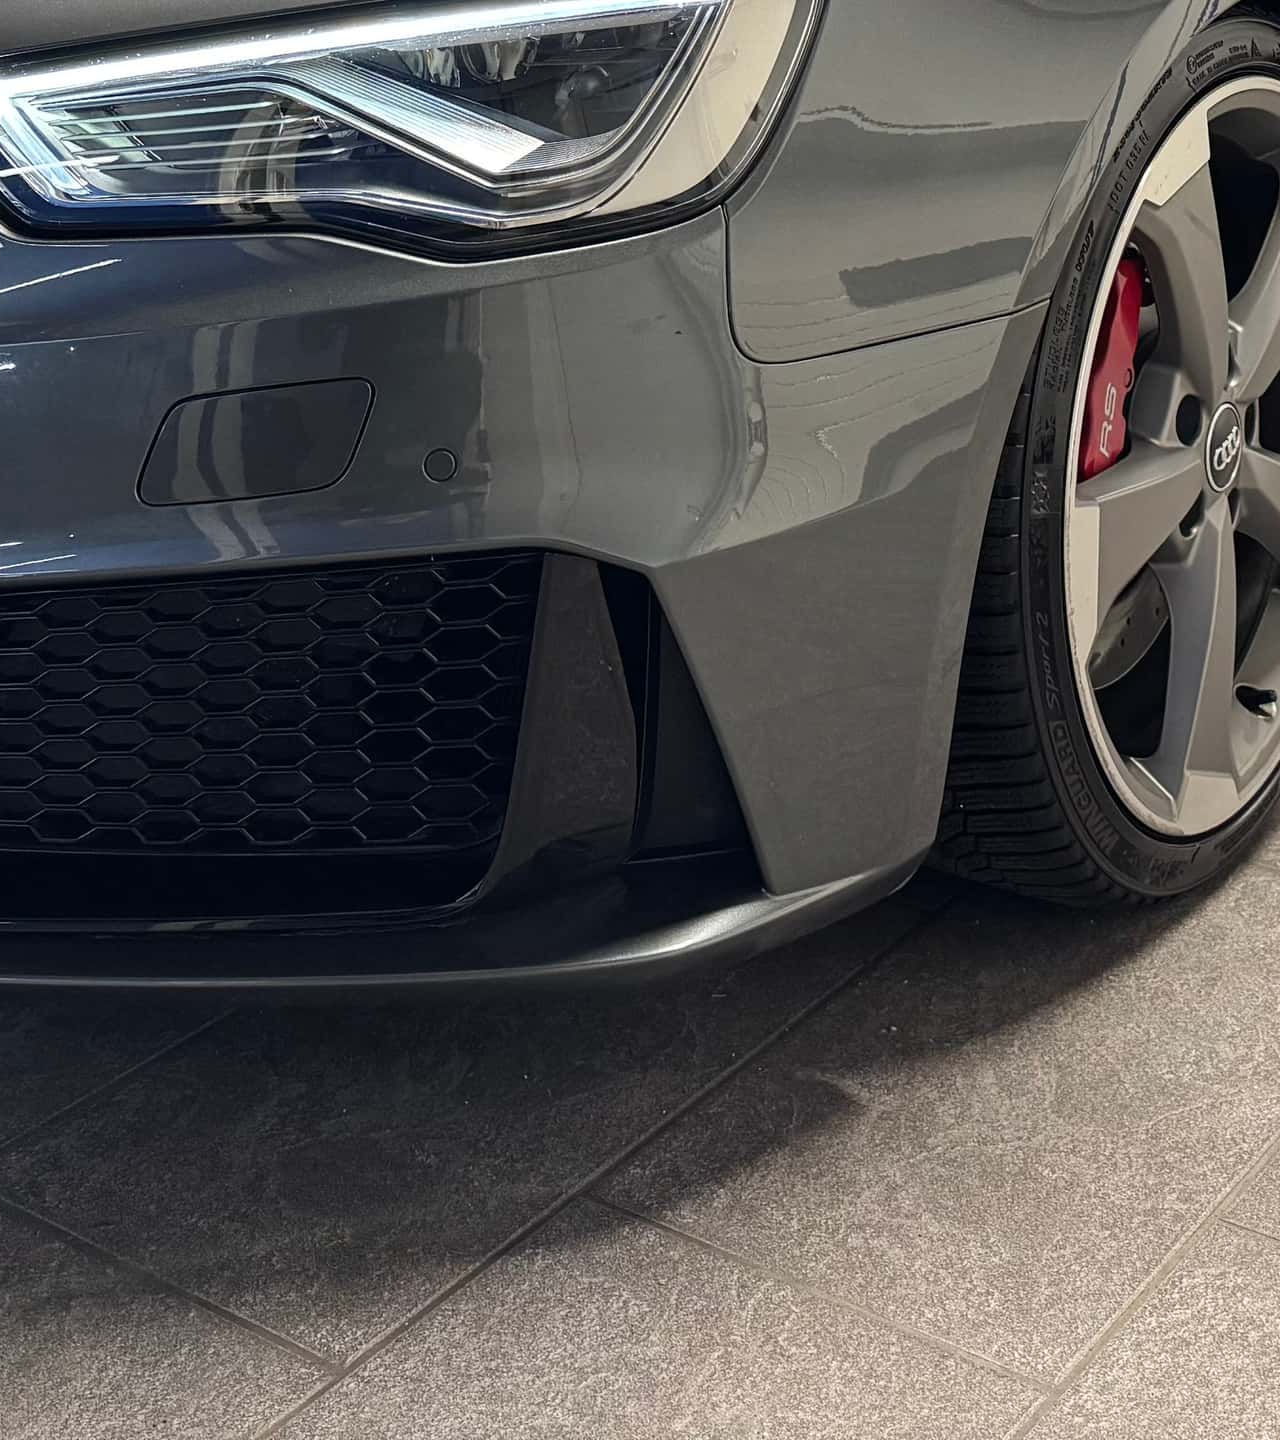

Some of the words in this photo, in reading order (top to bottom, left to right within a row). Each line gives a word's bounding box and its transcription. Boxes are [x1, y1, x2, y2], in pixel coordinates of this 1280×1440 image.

[1099, 381, 1118, 459] RS
[1036, 634, 1060, 710] Sport
[1051, 720, 1118, 854] WINGUARD
